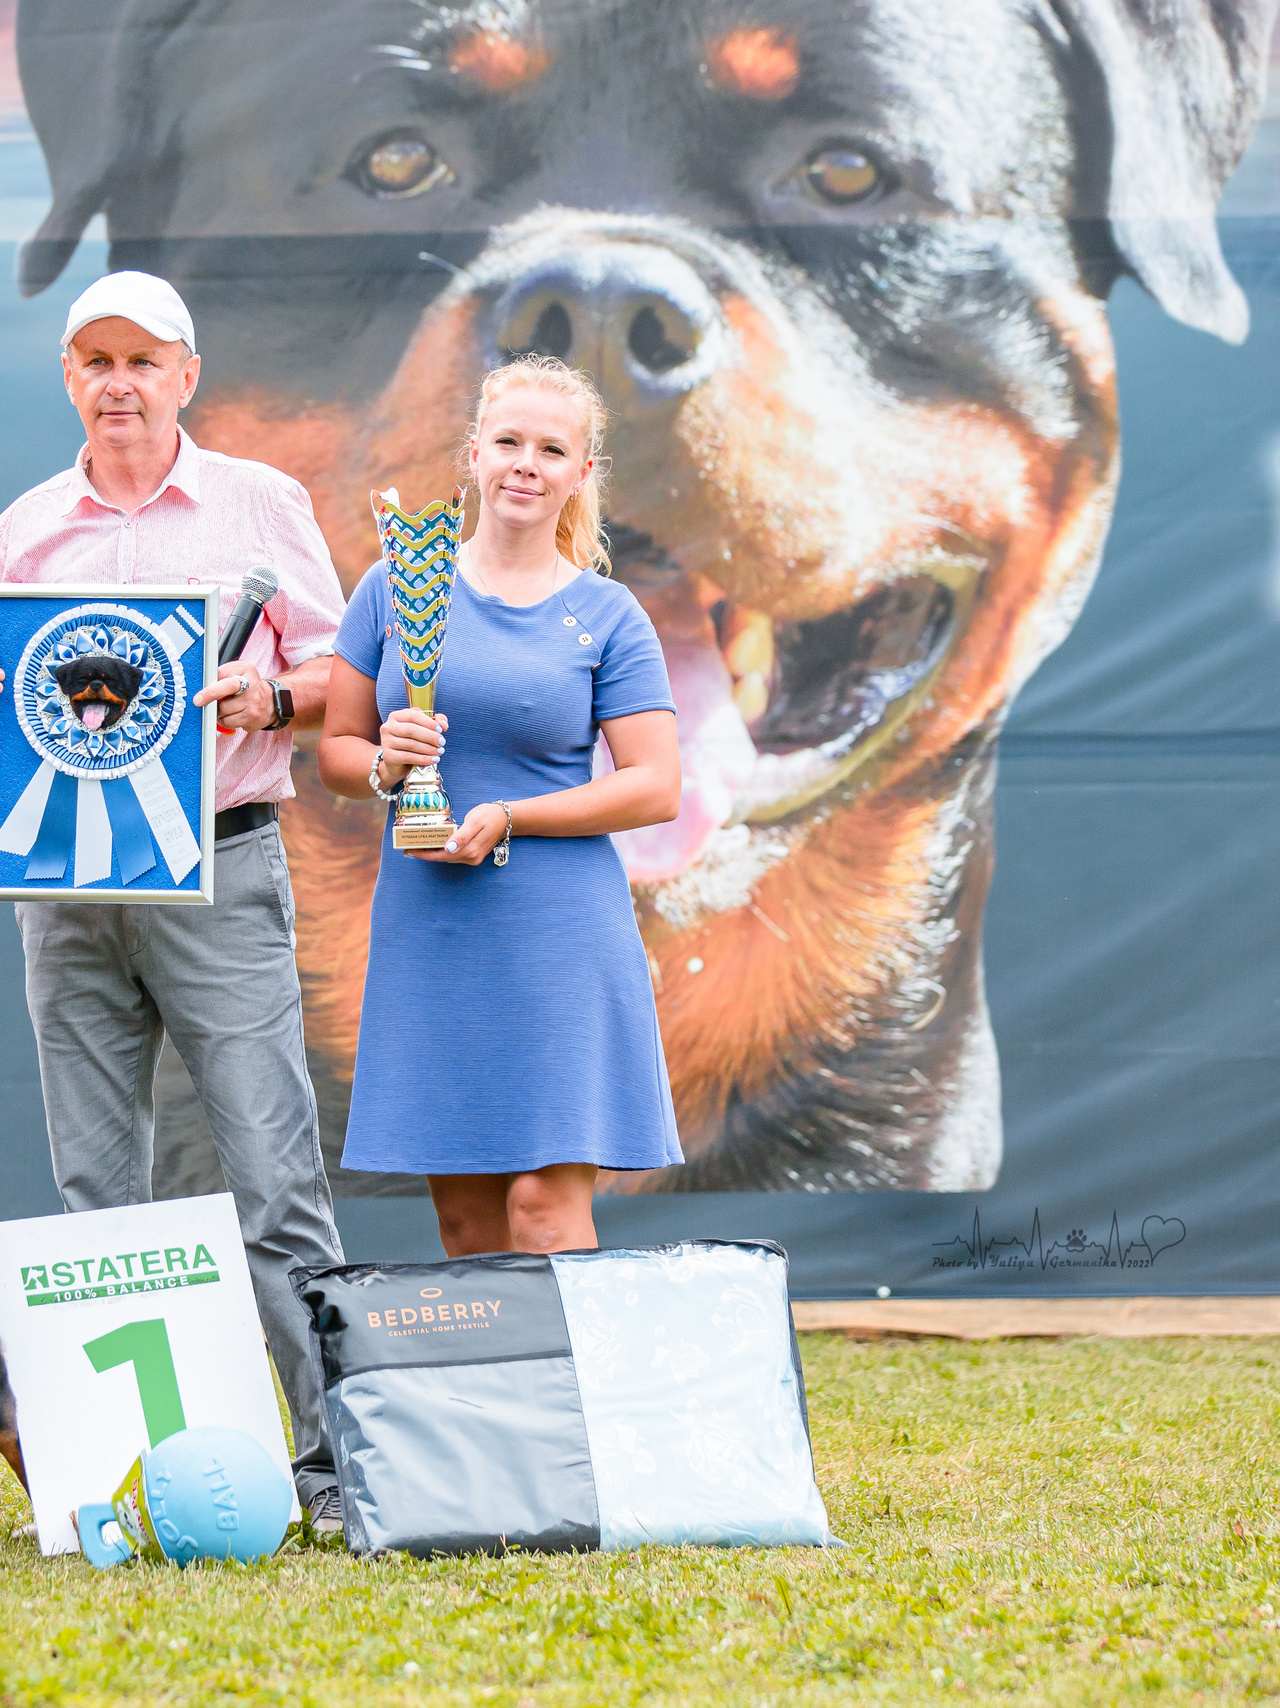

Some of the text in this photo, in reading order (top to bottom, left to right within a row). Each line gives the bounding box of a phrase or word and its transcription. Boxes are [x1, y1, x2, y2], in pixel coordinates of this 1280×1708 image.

[51, 1244, 217, 1287] STATERA
[54, 1276, 190, 1303] 100% BALANCE
[367, 1299, 501, 1328] BEDBERRY
[388, 1321, 490, 1337] CELESTIAL HOME TEXTILE
[82, 1318, 187, 1450] 1
[151, 1463, 198, 1549] JOLLY
[203, 1457, 239, 1530] BALL
